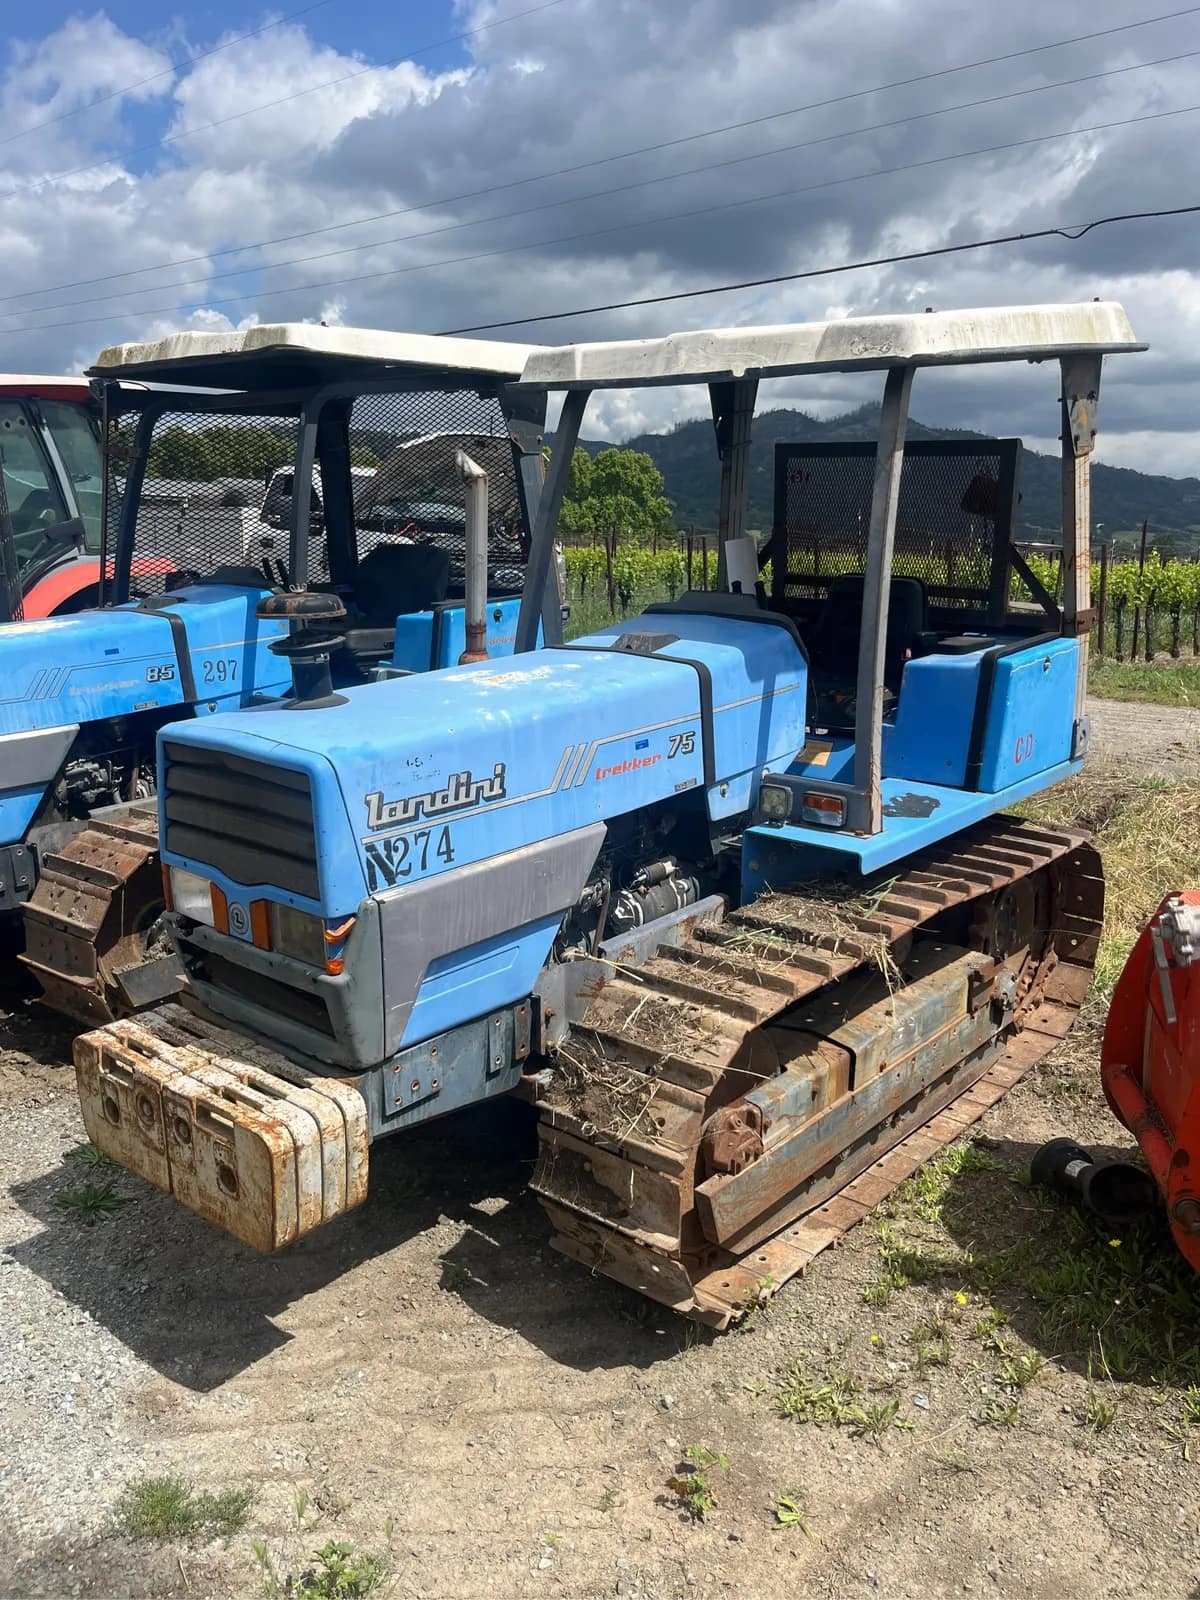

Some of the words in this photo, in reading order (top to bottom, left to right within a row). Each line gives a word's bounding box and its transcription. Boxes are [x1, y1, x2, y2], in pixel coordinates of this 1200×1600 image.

[146, 664, 175, 682] 85
[203, 660, 238, 682] 297
[667, 731, 695, 759] 75
[595, 753, 662, 781] trekker
